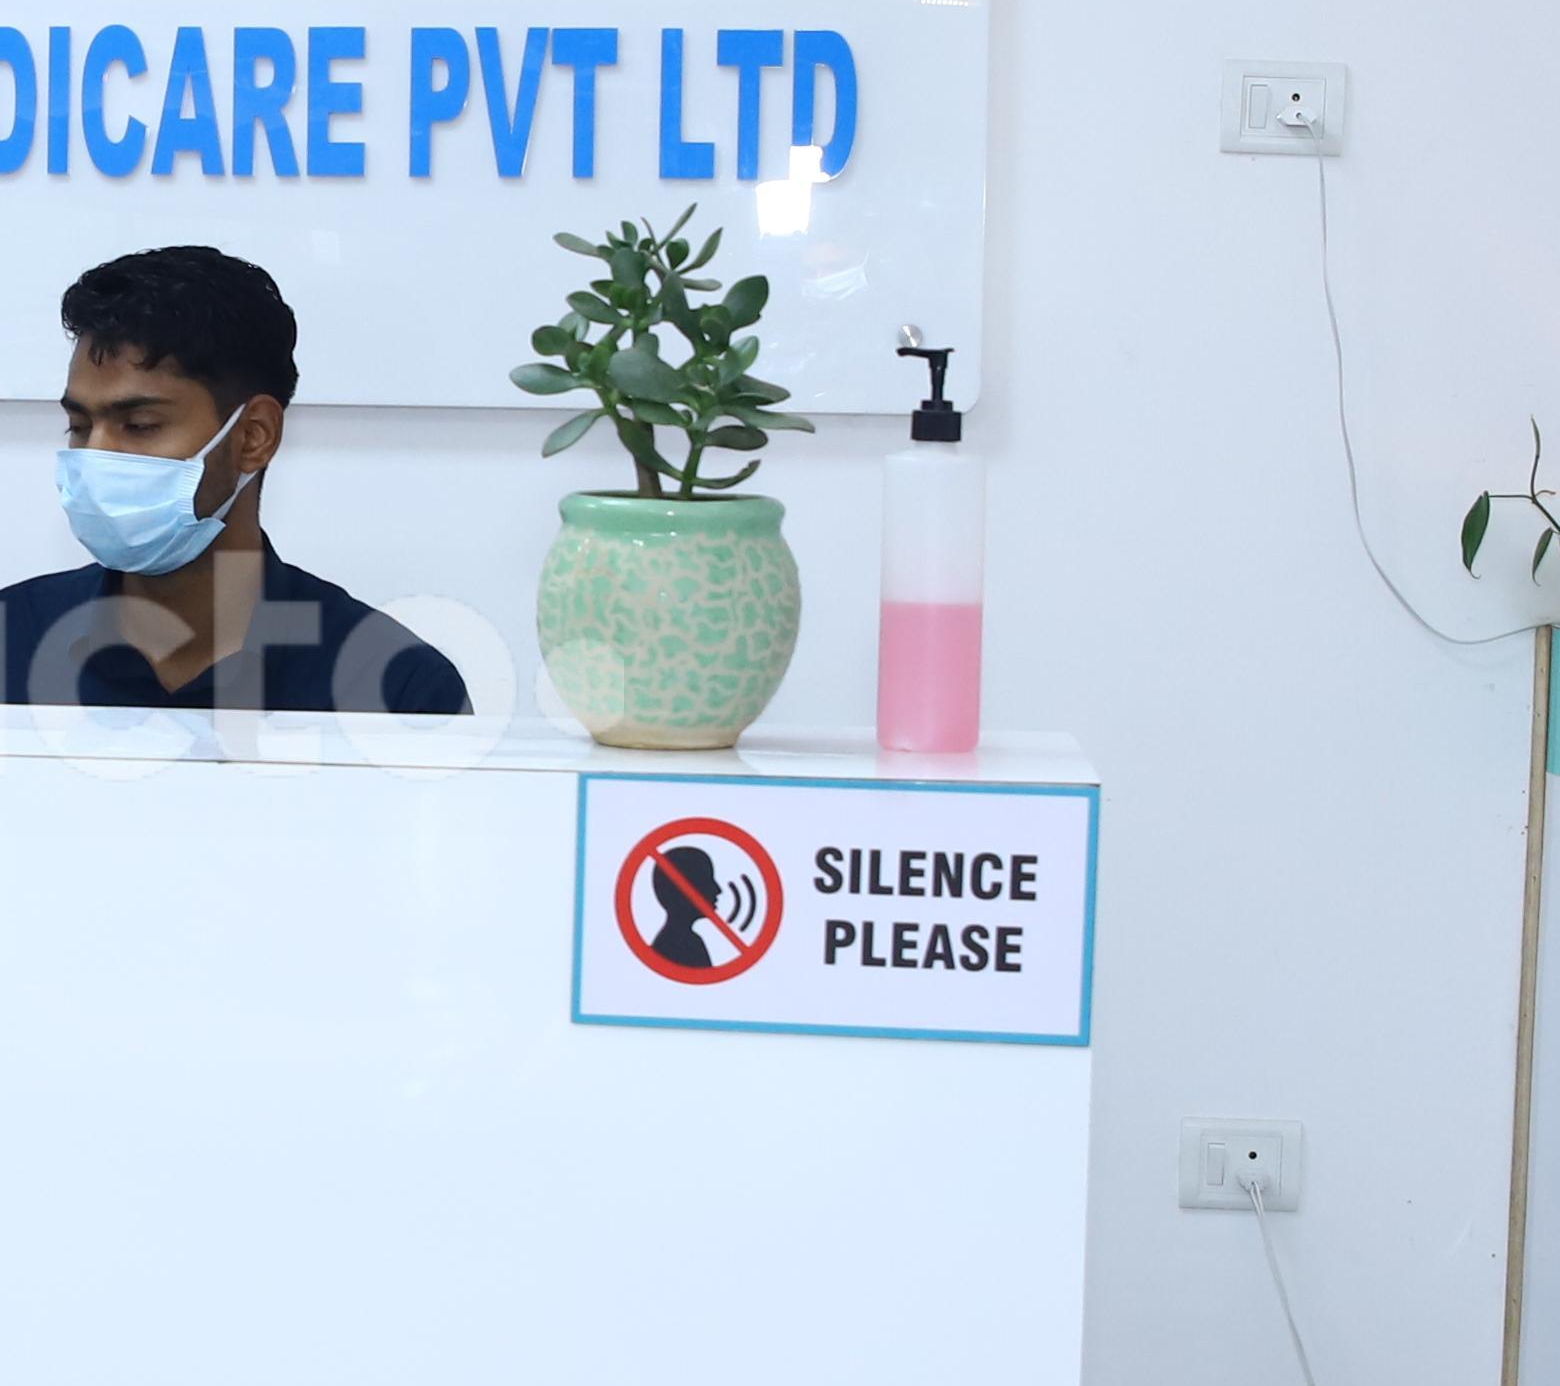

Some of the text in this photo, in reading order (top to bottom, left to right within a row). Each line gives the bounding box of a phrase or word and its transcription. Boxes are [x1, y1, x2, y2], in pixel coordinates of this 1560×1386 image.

[408, 26, 620, 179] PVT
[658, 27, 859, 182] LTD
[814, 847, 1039, 902] SILENCE
[824, 919, 1024, 973] PLEASE
